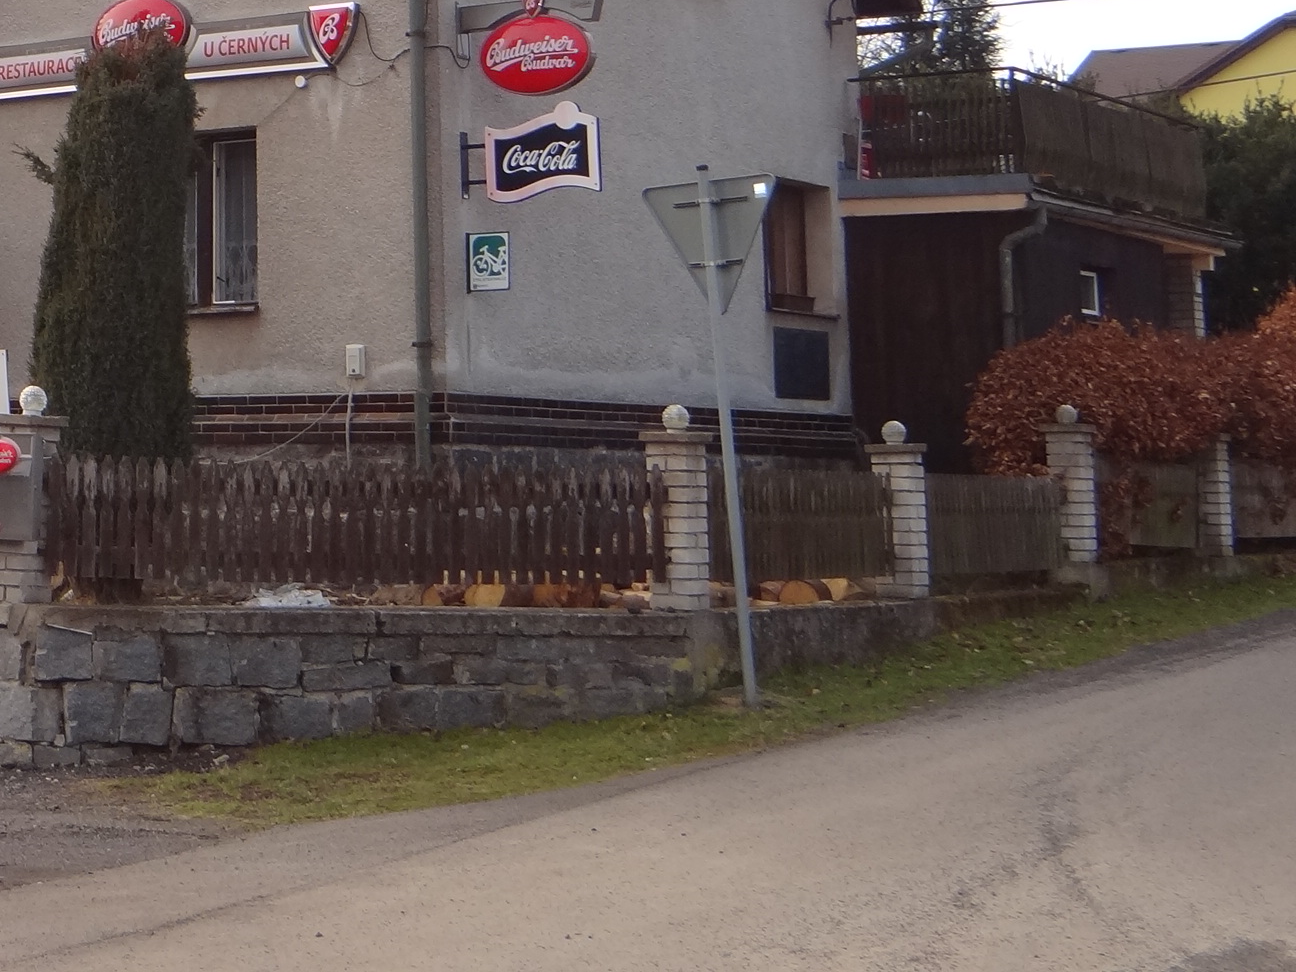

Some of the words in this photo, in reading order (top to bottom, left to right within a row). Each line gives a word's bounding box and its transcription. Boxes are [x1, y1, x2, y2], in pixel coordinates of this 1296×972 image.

[204, 41, 214, 57] U
[218, 32, 290, 56] ČERNÝCH
[486, 35, 578, 71] Budweiser
[521, 54, 575, 71] Budvar
[502, 140, 581, 173] Coca-Cola
